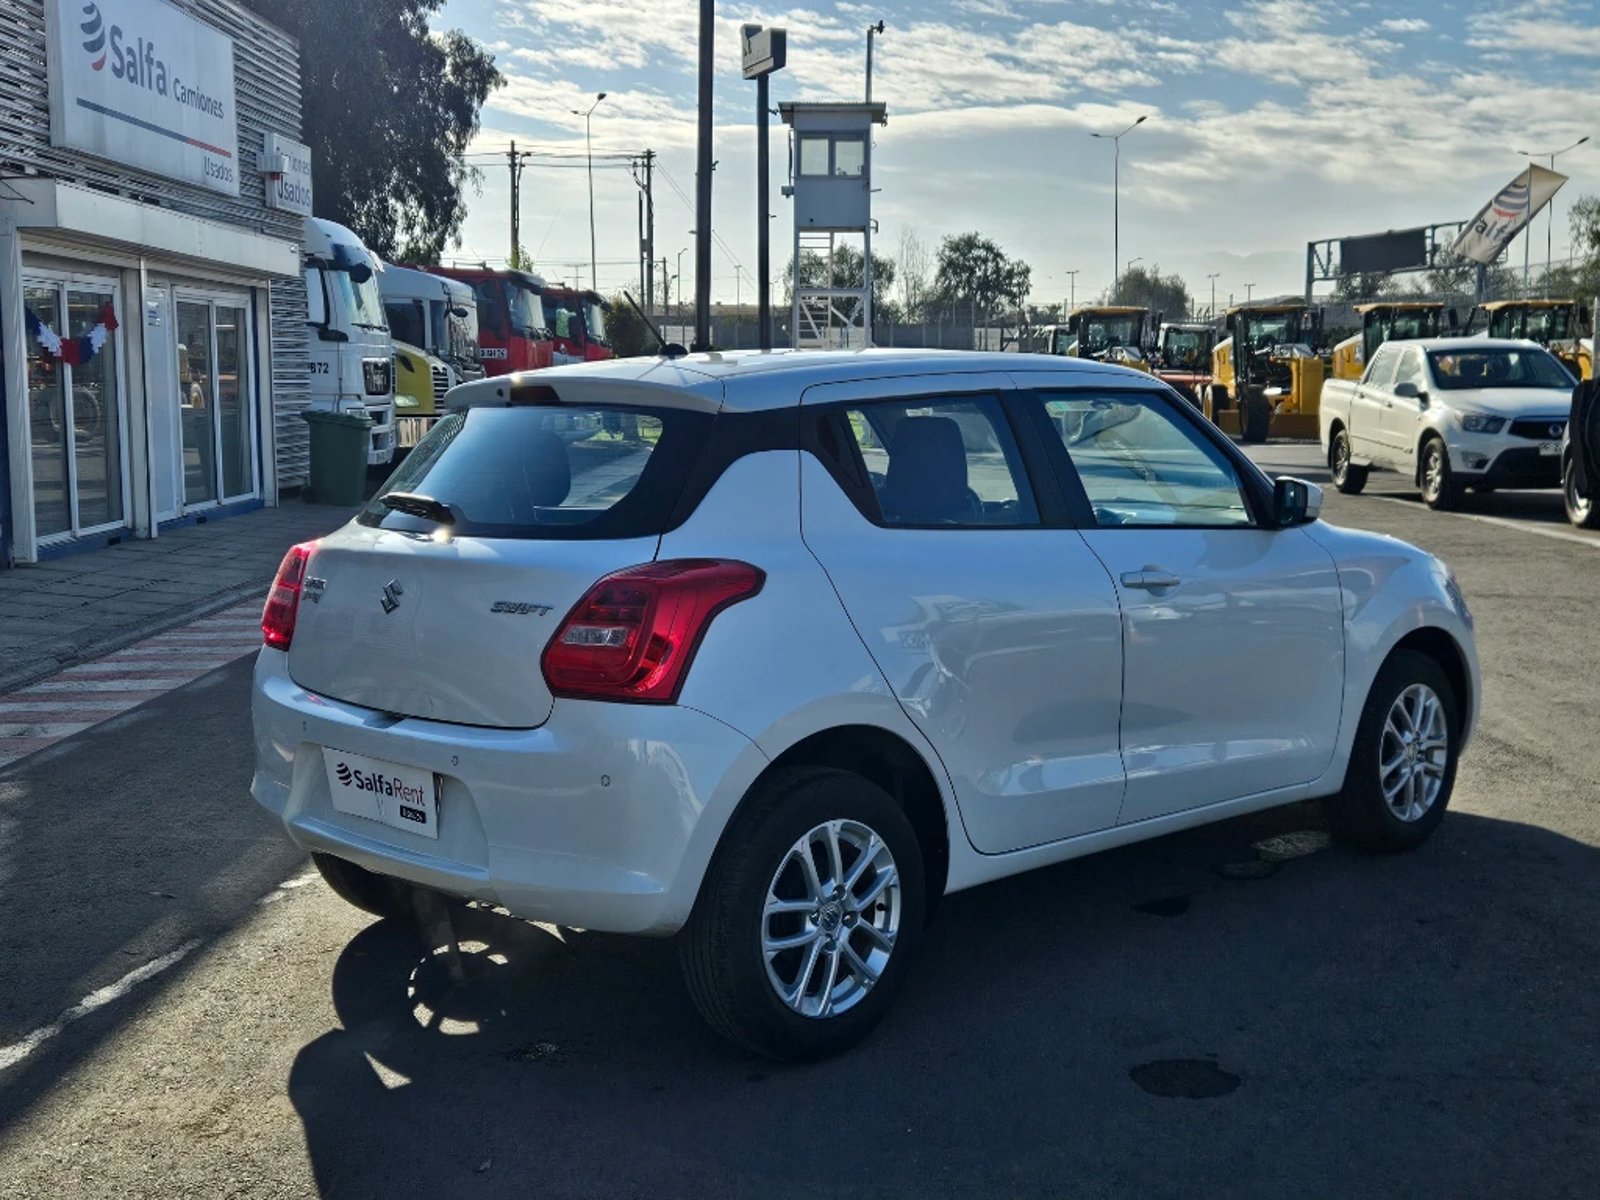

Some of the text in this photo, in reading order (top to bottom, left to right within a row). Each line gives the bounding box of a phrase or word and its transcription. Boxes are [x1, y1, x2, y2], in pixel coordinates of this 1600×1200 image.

[109, 24, 225, 120] Salfa Camiones
[203, 155, 234, 184] Usados
[490, 601, 555, 617] SWIFT
[352, 769, 426, 807] SalfaRent
